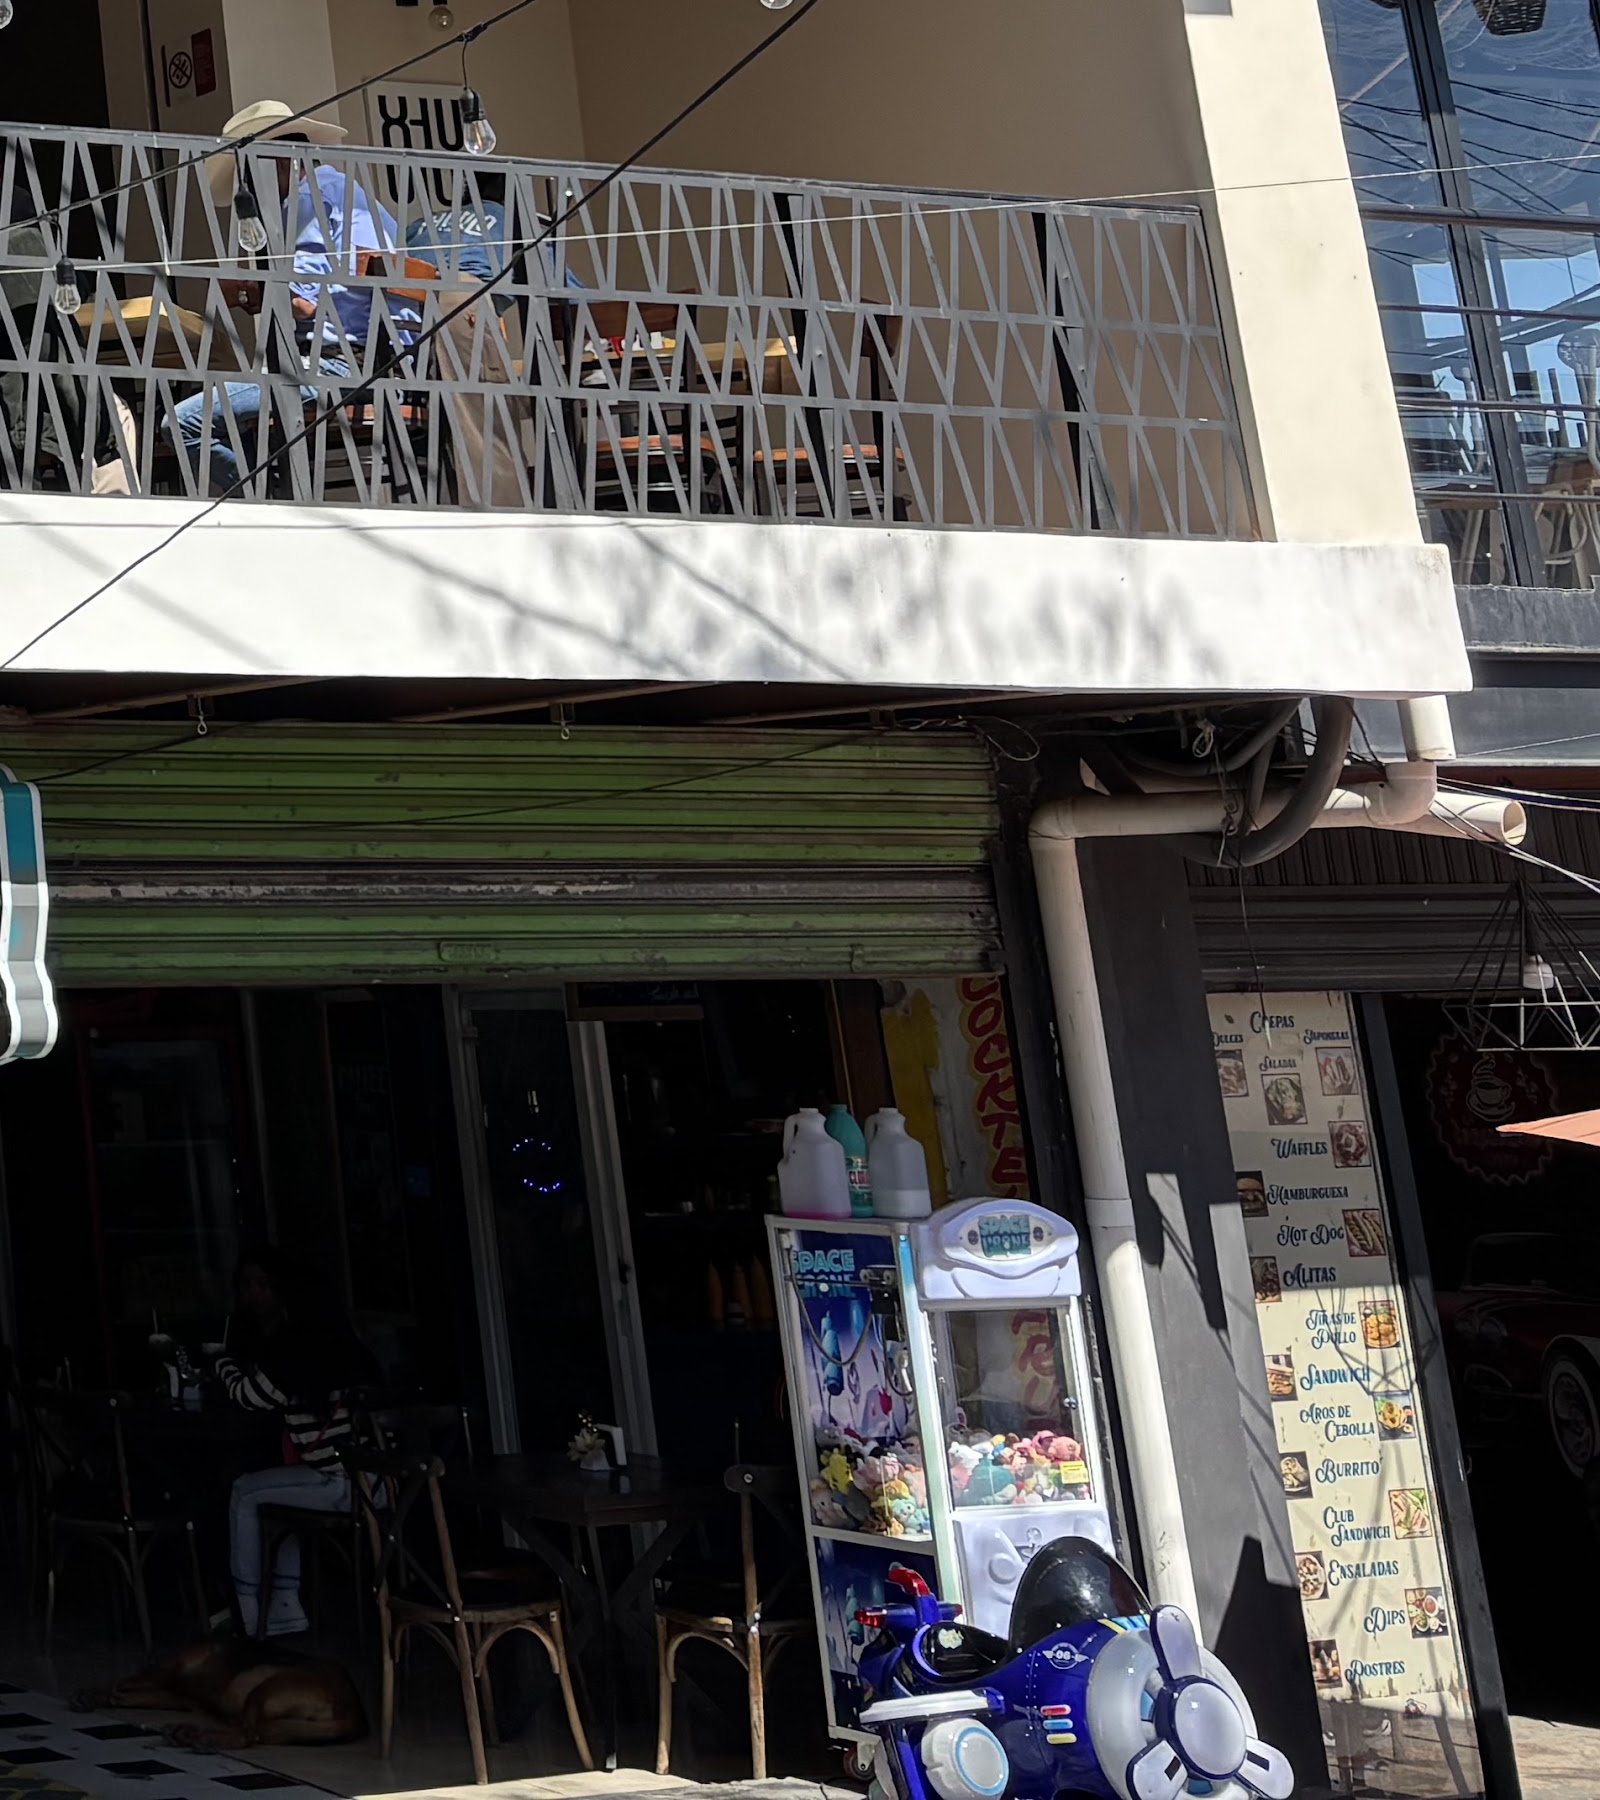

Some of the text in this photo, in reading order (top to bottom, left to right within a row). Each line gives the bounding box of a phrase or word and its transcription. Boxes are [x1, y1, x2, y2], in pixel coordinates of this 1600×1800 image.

[1266, 1184, 1349, 1206] HAMBURGUESA
[1282, 1263, 1337, 1289] ALITAS
[1337, 1405, 1352, 1418] DE
[1323, 1506, 1355, 1530] CLUB
